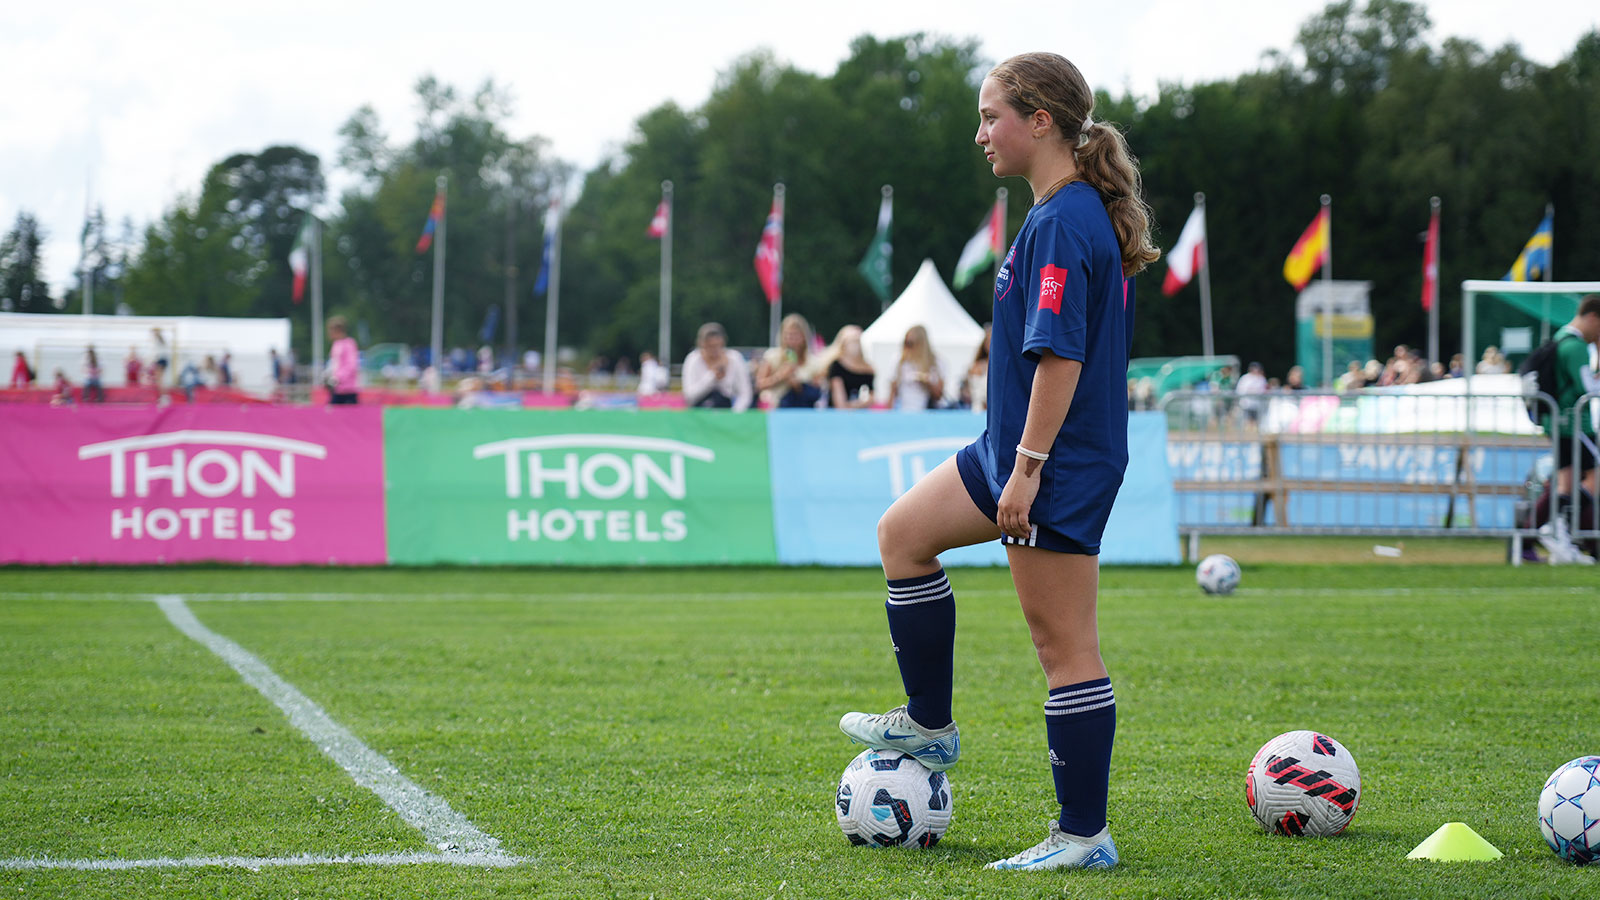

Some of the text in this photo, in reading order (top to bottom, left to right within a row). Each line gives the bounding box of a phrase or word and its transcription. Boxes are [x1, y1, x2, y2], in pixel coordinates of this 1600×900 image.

[79, 430, 326, 497] THON
[473, 434, 715, 499] THON
[111, 507, 295, 541] HOTELS
[507, 508, 688, 542] HOTELS
